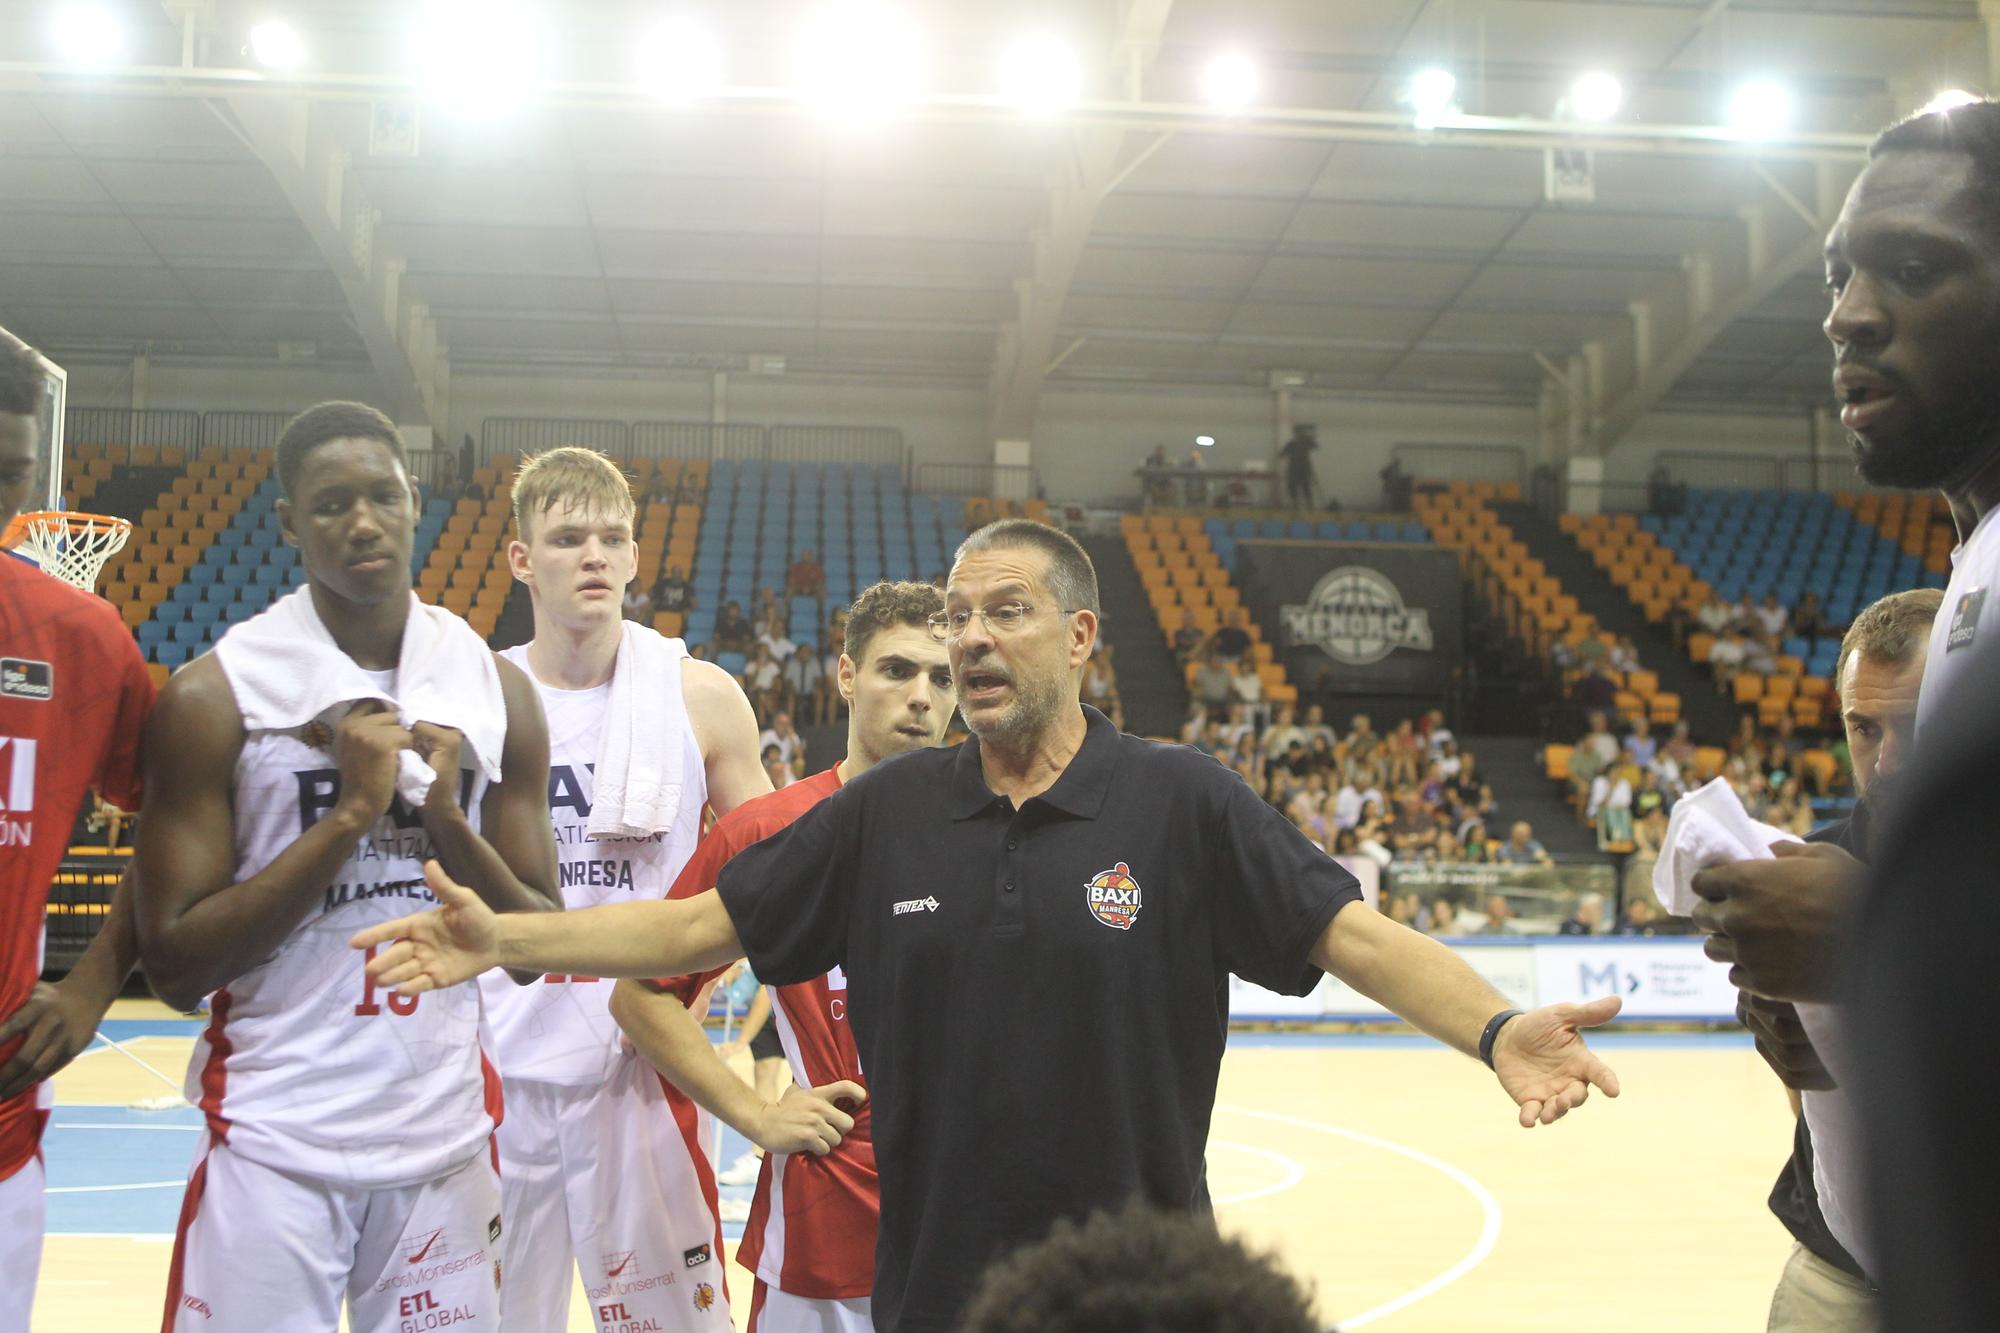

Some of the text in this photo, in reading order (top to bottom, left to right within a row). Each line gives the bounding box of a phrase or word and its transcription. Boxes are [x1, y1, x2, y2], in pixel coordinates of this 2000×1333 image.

[1281, 604, 1434, 650] MENORCA
[1091, 886, 1139, 905] BAXI
[1100, 904, 1130, 916] MANRESA
[688, 1253, 706, 1266] acb
[399, 1289, 439, 1317] ETL
[599, 1303, 631, 1323] ETL
[400, 1304, 476, 1333] GLOBAL
